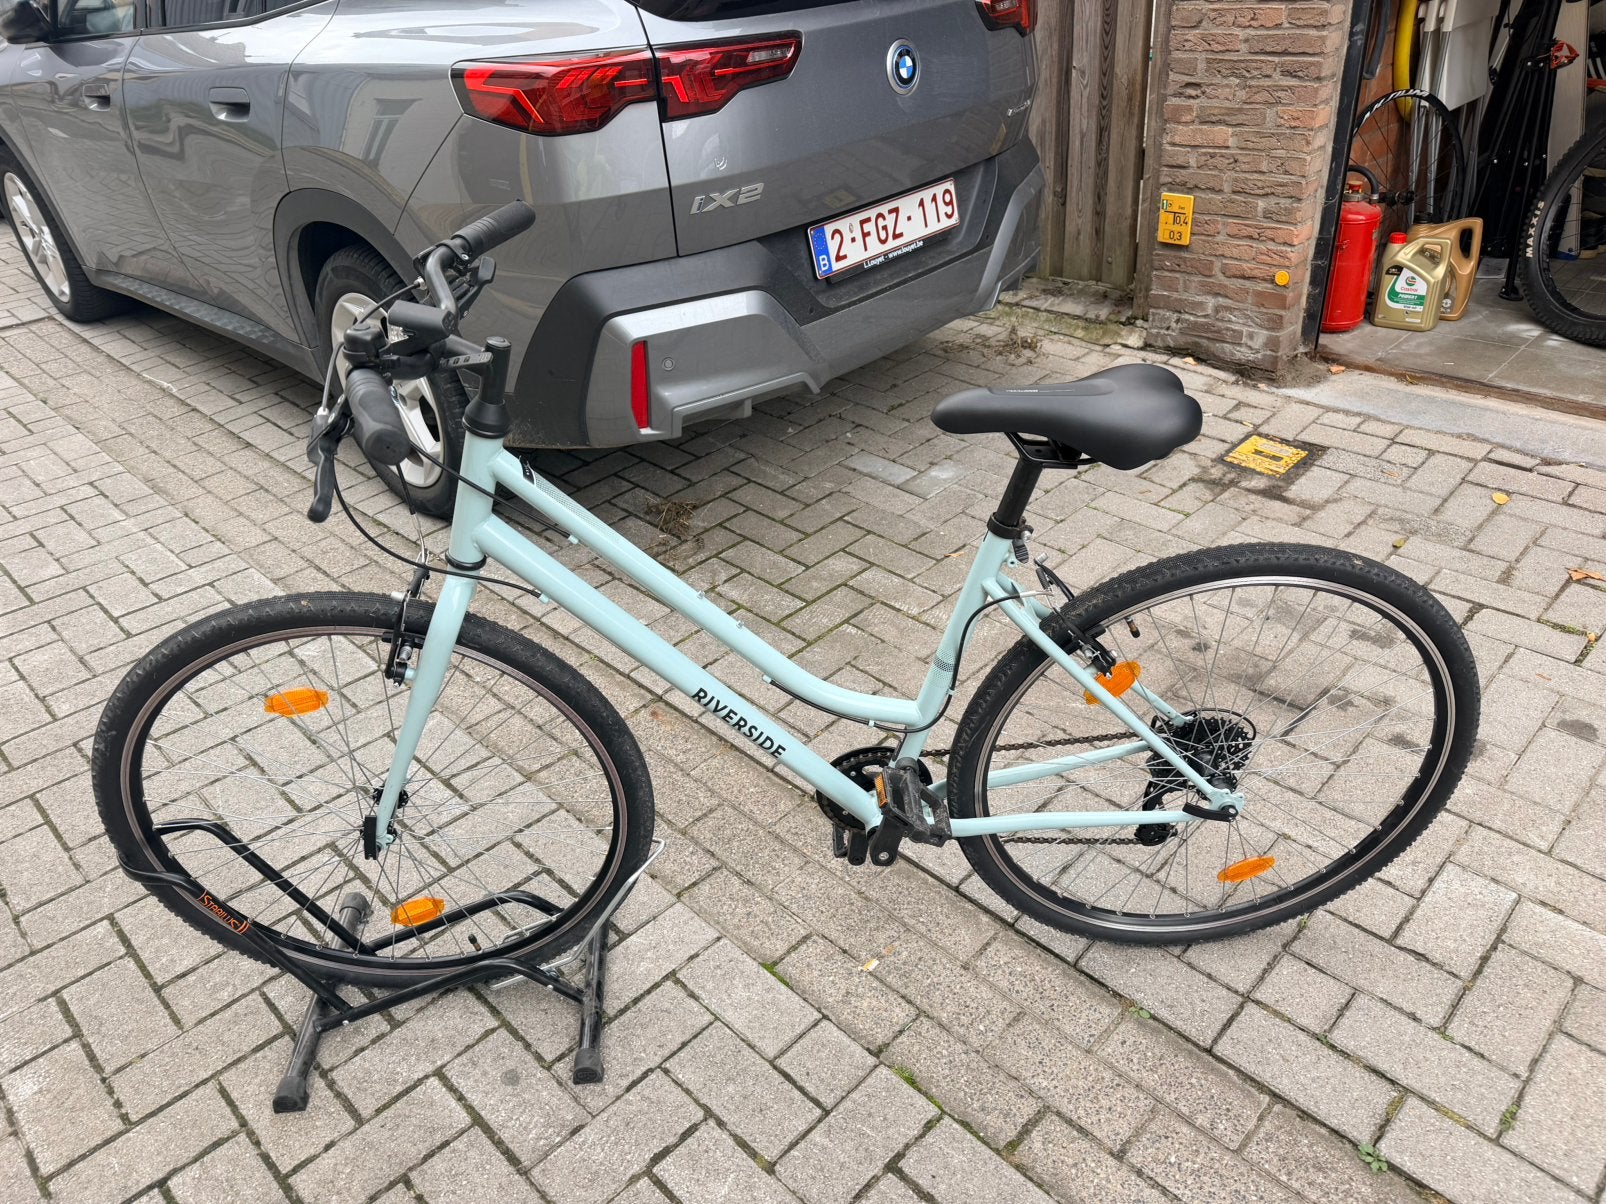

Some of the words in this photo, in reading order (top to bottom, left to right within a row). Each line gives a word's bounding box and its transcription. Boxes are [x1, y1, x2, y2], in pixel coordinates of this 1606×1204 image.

[690, 183, 764, 214] iX2
[1169, 230, 1182, 242] 0,3
[1526, 200, 1545, 258] MAXXIS
[819, 255, 829, 271] B
[691, 687, 787, 759] RIVERSIDE
